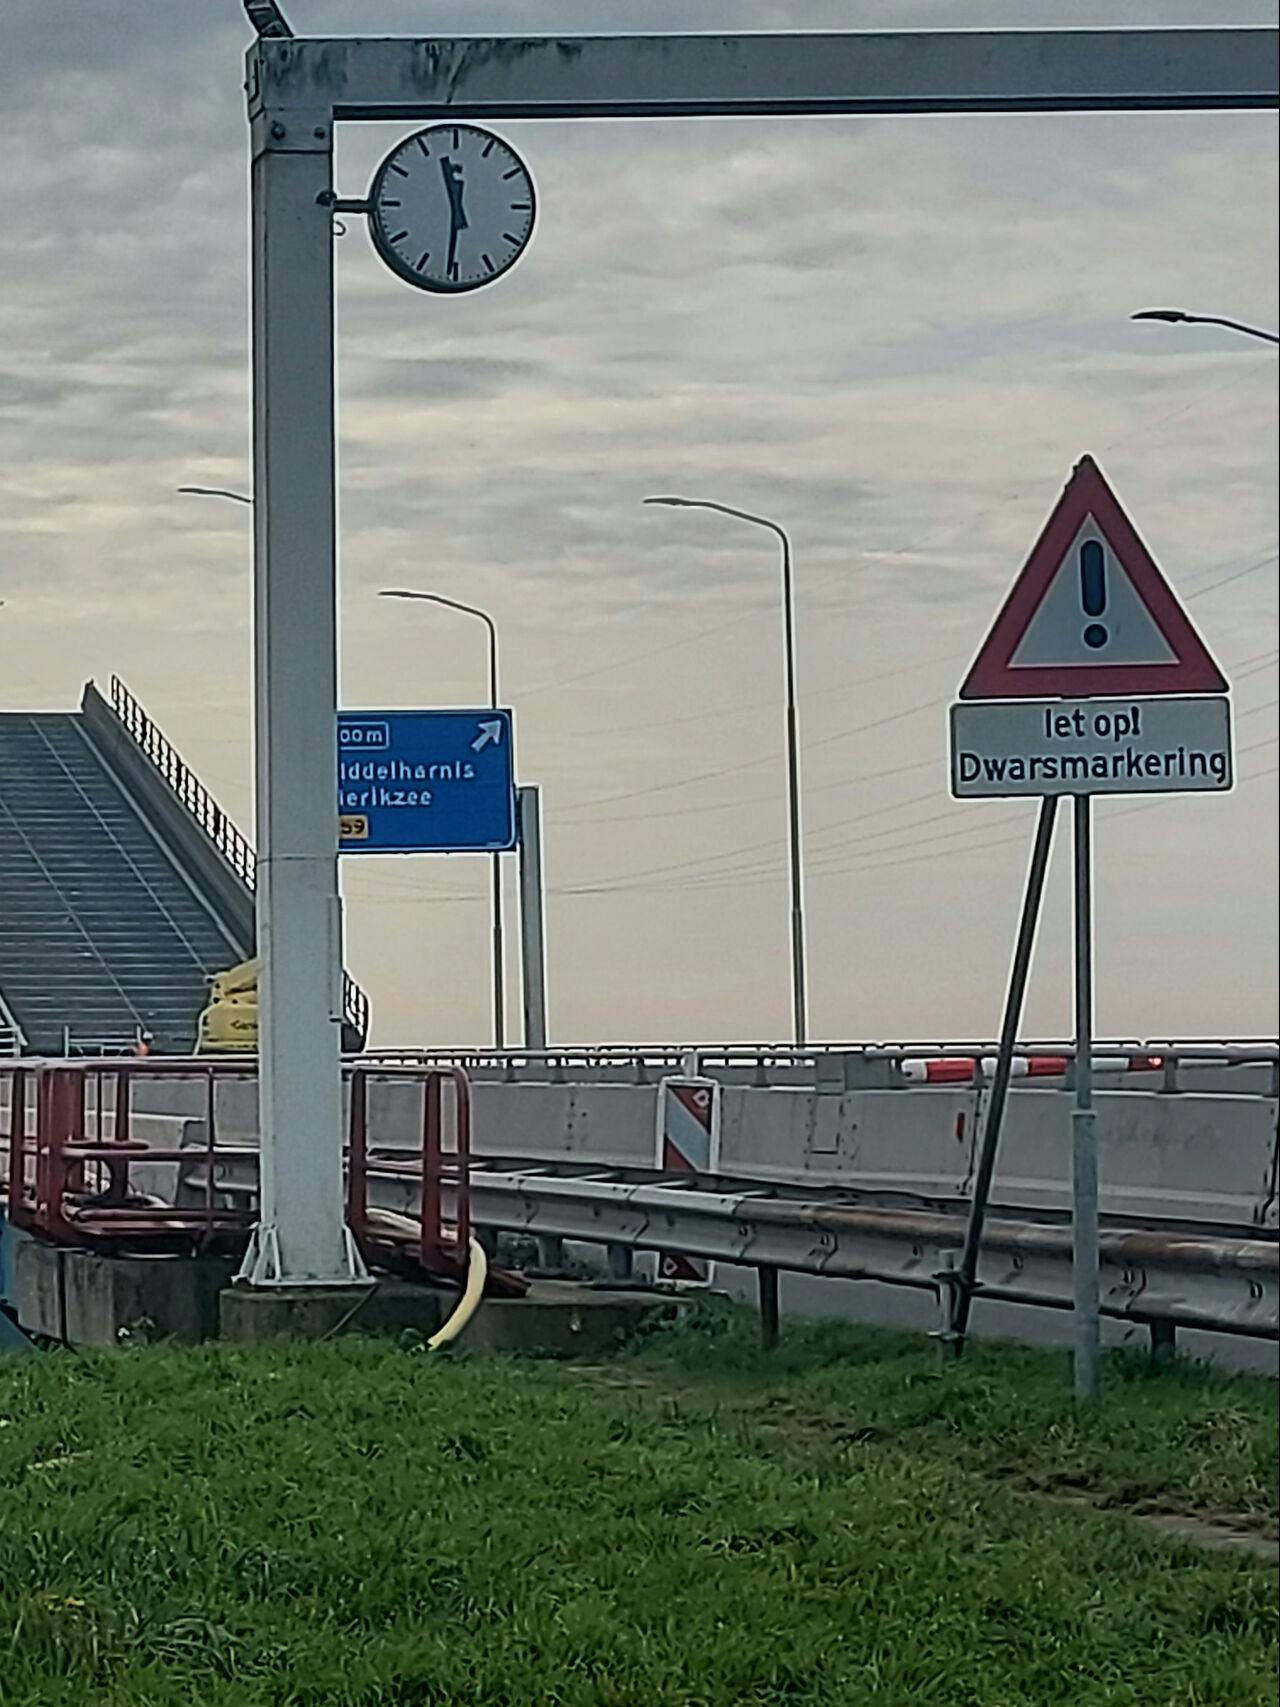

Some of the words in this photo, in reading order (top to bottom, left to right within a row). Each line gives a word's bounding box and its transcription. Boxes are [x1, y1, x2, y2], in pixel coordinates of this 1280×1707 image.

[1094, 706, 1140, 742] op!
[340, 760, 476, 780] iddelharnis
[958, 747, 1227, 784] Dwarsmarkering
[339, 786, 433, 806] ierikzee
[340, 818, 366, 834] 59
